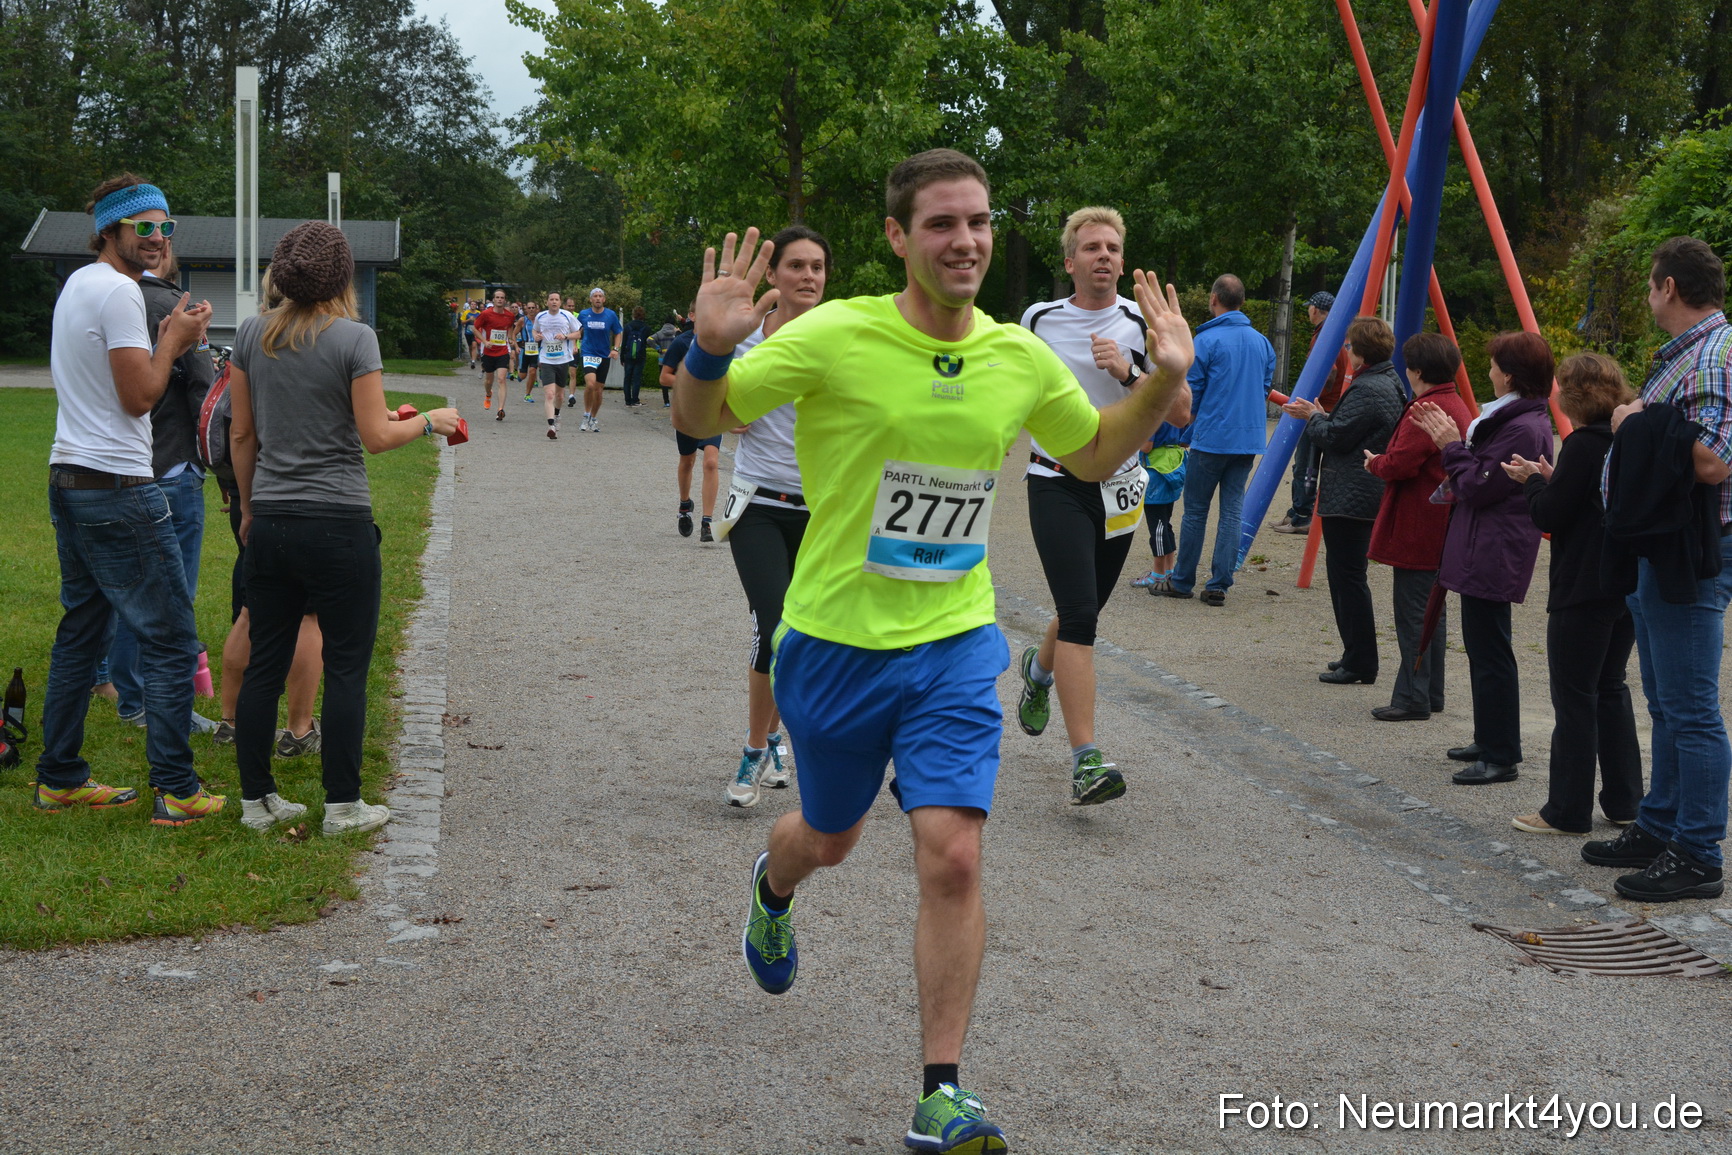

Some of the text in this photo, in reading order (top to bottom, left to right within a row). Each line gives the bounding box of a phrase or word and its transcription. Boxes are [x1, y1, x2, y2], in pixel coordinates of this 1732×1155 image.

[547, 344, 563, 353] 2345
[884, 470, 981, 492] PARTL Neumarkt
[885, 489, 985, 538] 2777
[913, 548, 945, 565] Ralf
